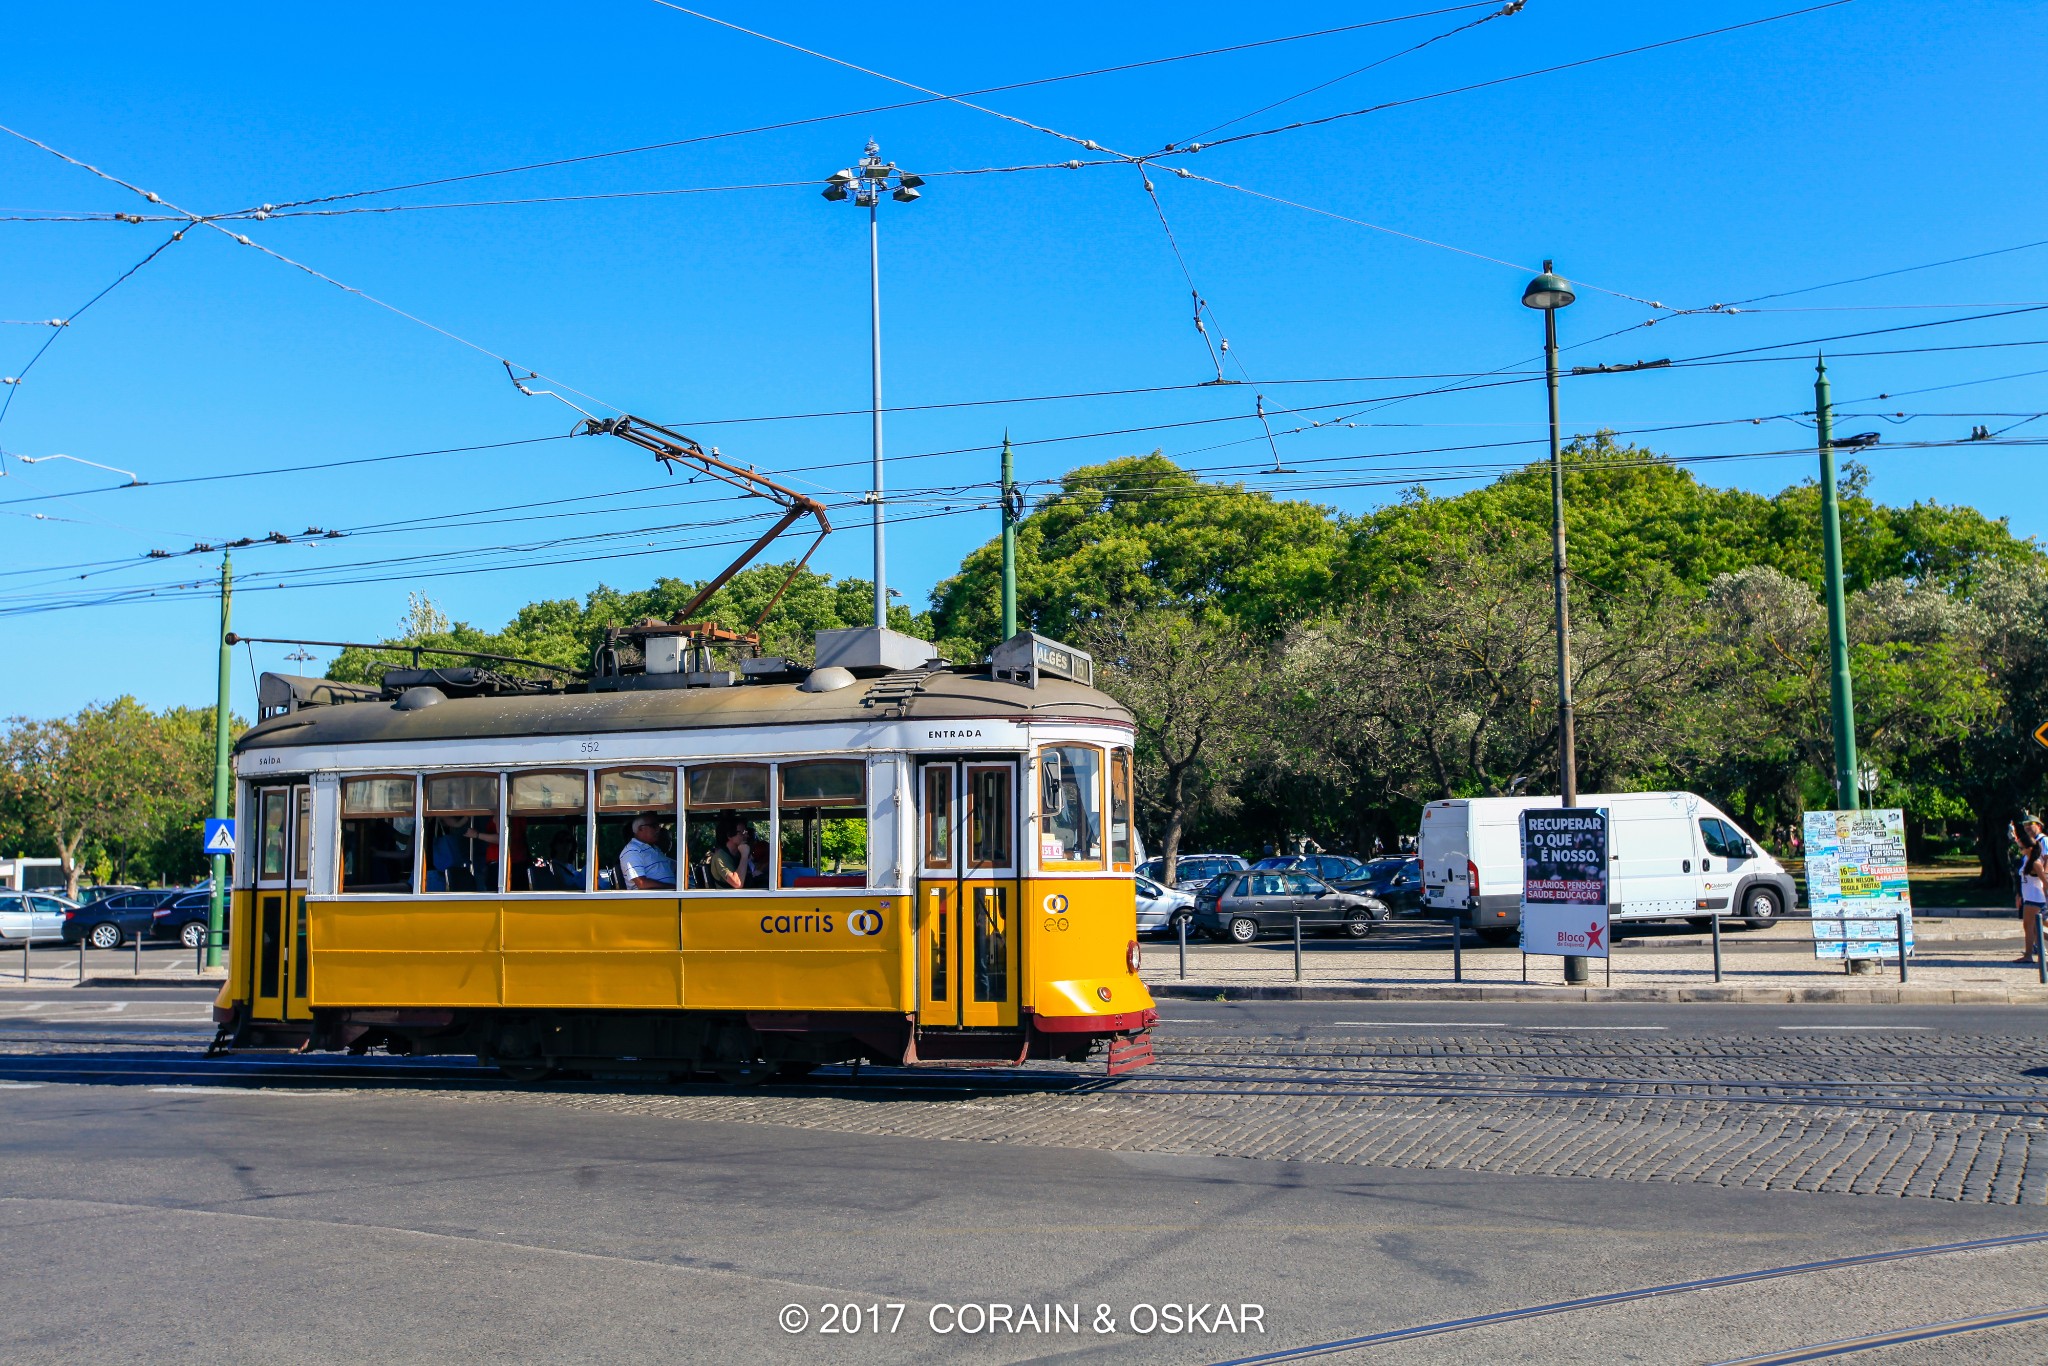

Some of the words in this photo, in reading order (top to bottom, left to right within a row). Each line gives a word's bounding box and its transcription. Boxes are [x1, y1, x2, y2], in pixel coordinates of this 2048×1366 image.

[1037, 646, 1067, 669] ALGÉS
[928, 730, 982, 738] ENTRADA
[581, 741, 599, 752] 552
[259, 756, 281, 765] SAÍDA
[1528, 817, 1601, 831] RECUPERAR
[1534, 834, 1544, 846] O
[1546, 834, 1573, 848] QUE
[1541, 847, 1549, 862] É
[1551, 849, 1600, 863] NOSSO.
[1528, 879, 1566, 890] SALÁRIOS,
[1567, 880, 1601, 890] PENSÕES
[1528, 887, 1556, 899] SAÚDE,
[1556, 890, 1598, 901] EDUCAÇÃO
[760, 907, 834, 934] carris
[1557, 931, 1585, 943] Bloco
